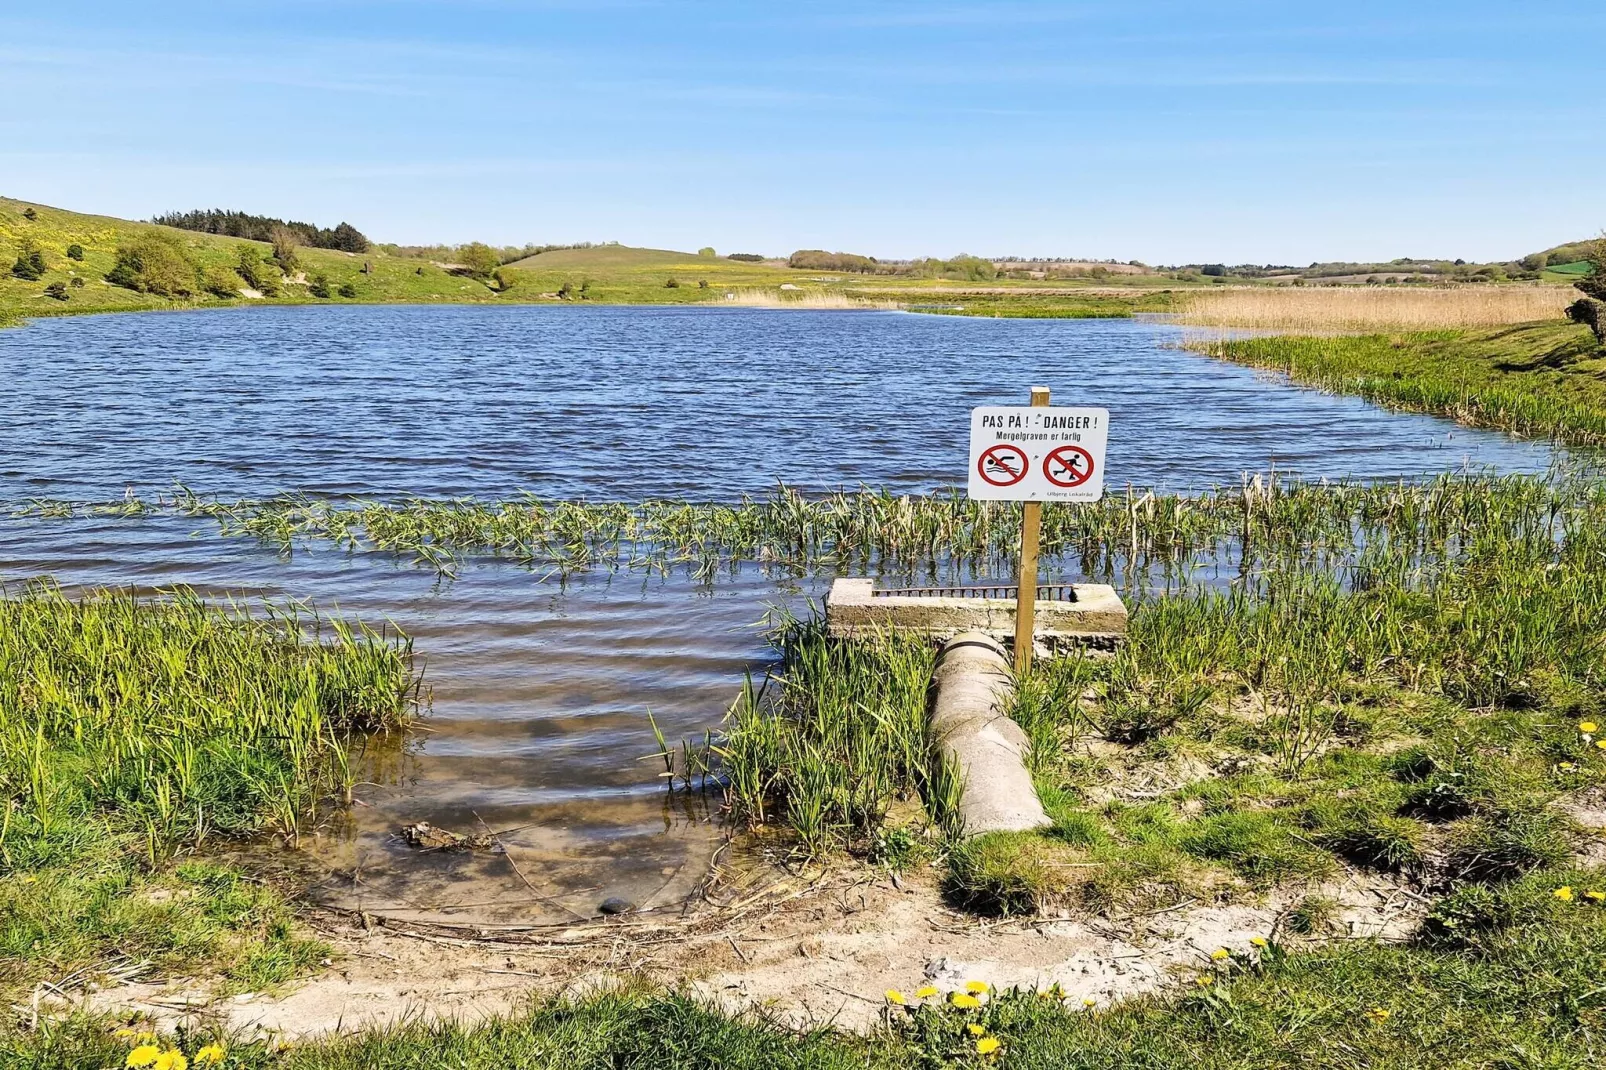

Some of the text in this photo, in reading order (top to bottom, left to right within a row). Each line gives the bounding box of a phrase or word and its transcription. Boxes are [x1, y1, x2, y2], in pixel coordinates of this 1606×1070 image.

[982, 415, 1004, 428] PAS
[1043, 416, 1090, 429] DANGER
[996, 431, 1081, 442] Mergelgraven er farlig
